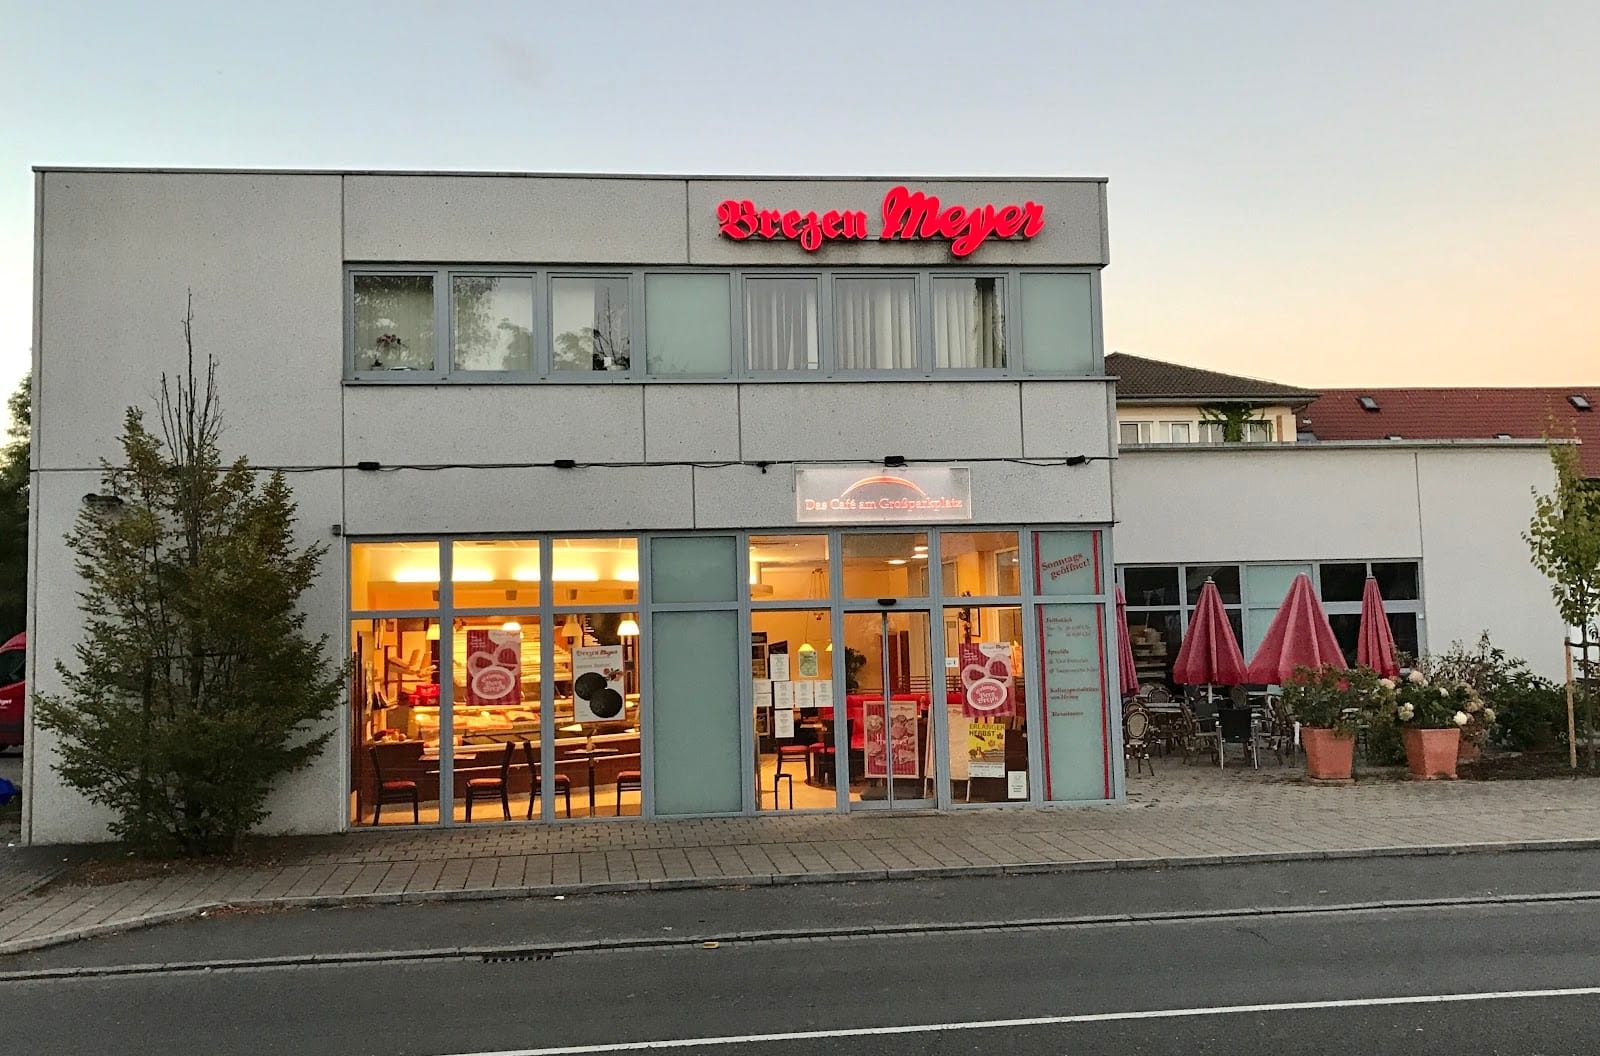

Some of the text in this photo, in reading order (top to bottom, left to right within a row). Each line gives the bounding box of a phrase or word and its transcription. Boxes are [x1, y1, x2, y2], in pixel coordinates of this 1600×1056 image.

[716, 185, 1046, 257] Brezen Meyer
[804, 497, 963, 512] Das Café am Großparkplatz
[1041, 553, 1084, 571] Sonntags
[1050, 558, 1090, 581] geöffnet!
